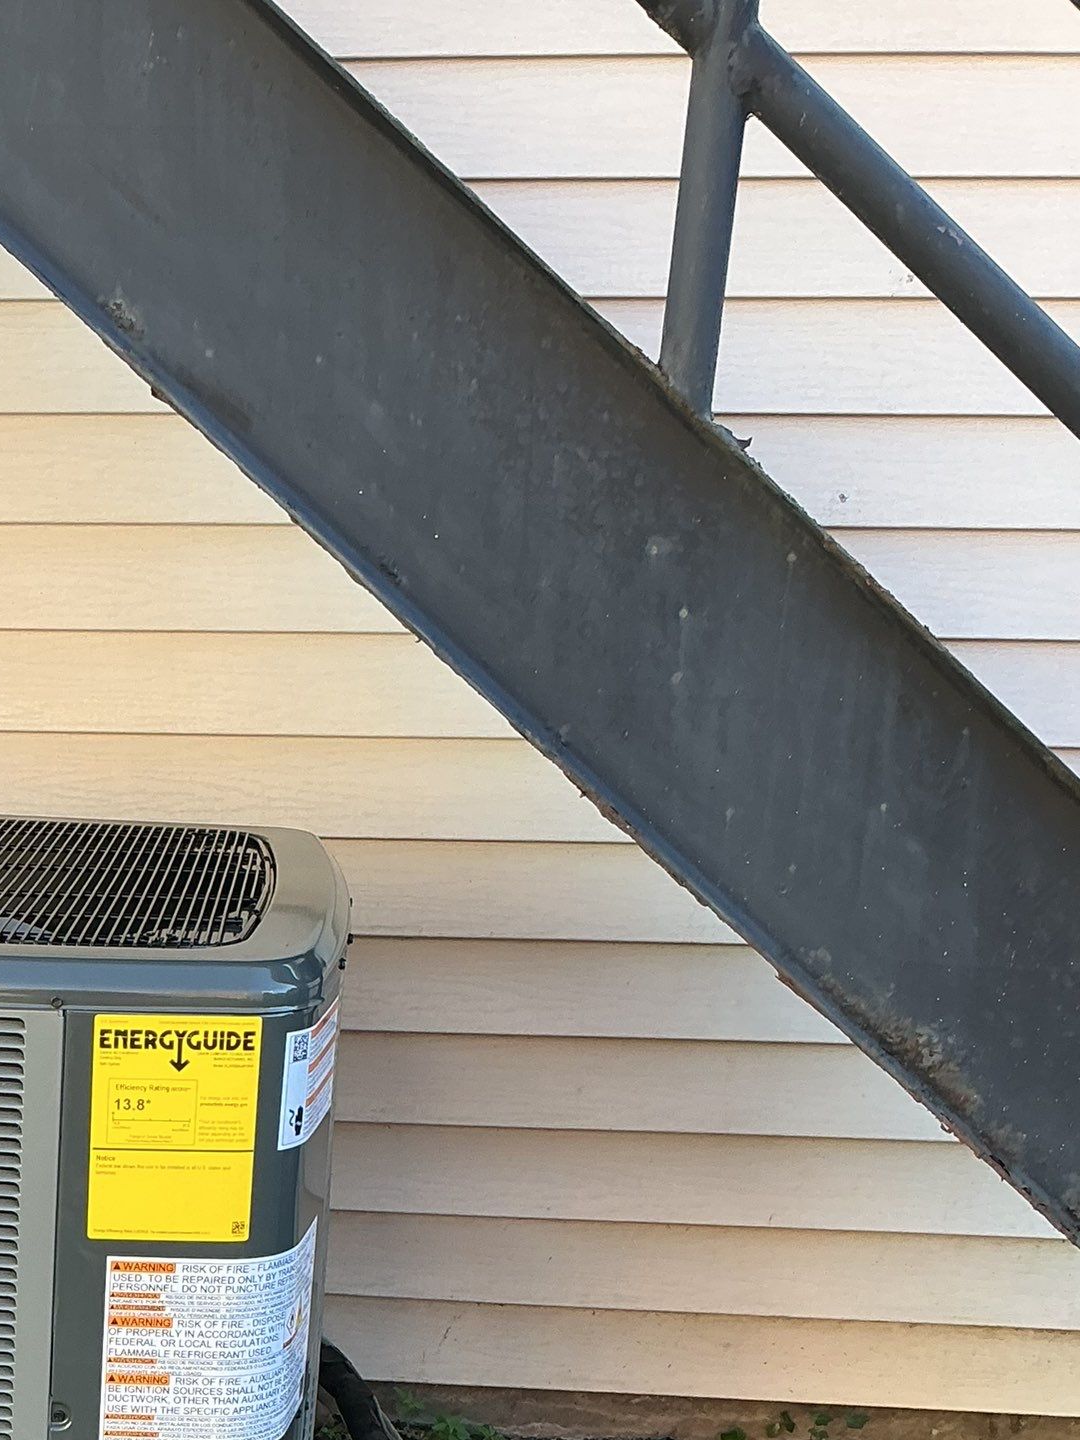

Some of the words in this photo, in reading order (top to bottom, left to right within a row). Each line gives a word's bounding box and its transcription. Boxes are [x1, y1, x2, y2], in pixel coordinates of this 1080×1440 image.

[99, 1028, 256, 1052] ENERGYGUIDE
[115, 1083, 147, 1092] Efficiency
[149, 1084, 170, 1093] Rating
[96, 1154, 116, 1162] Notice
[123, 1262, 174, 1272] WARNING
[182, 1264, 207, 1273] RISK
[209, 1265, 223, 1274] OF
[226, 1265, 250, 1274] FIRE
[148, 1274, 163, 1283] TO
[165, 1274, 179, 1284] BE
[182, 1275, 235, 1284] REPAIRED
[237, 1274, 264, 1284] ONLY
[265, 1272, 276, 1282] BY
[181, 1284, 197, 1293] DO
[200, 1285, 222, 1293] NOT
[225, 1281, 276, 1294] PUNCTURE
[120, 1318, 171, 1328] WARNING
[177, 1320, 201, 1328] RISK
[204, 1320, 219, 1329] OF
[221, 1320, 245, 1329] FIRE
[252, 1311, 286, 1328] DISPOSE
[108, 1328, 123, 1336] OF
[126, 1328, 182, 1338] PROPERLY
[184, 1330, 195, 1338] IN
[197, 1327, 266, 1339] ACCORDANCE
[268, 1322, 285, 1334] WITH
[109, 1337, 157, 1347] FEDERAL
[160, 1339, 176, 1347] OR
[179, 1339, 212, 1348] LOCAL
[108, 1348, 170, 1358] FLAMMABLE
[173, 1349, 246, 1359] REFRIGERANT
[118, 1375, 168, 1384] WARNING
[175, 1377, 199, 1386] RISK
[201, 1378, 216, 1386] OF
[218, 1377, 241, 1386] FIRE
[249, 1367, 285, 1384] AUXILIARY
[108, 1385, 123, 1393] BE
[124, 1386, 170, 1394] IGNITION
[173, 1387, 223, 1396] SOURCES
[225, 1386, 255, 1395] SHALL
[258, 1380, 273, 1391] NOT
[275, 1378, 282, 1387] BE
[173, 1396, 210, 1405] OTHER
[213, 1396, 239, 1405] THAN
[241, 1389, 280, 1404] AUXILIARY
[107, 1405, 128, 1413] USE
[183, 1407, 230, 1416] SPECIFIC
[232, 1399, 277, 1415] APPLIANCE
